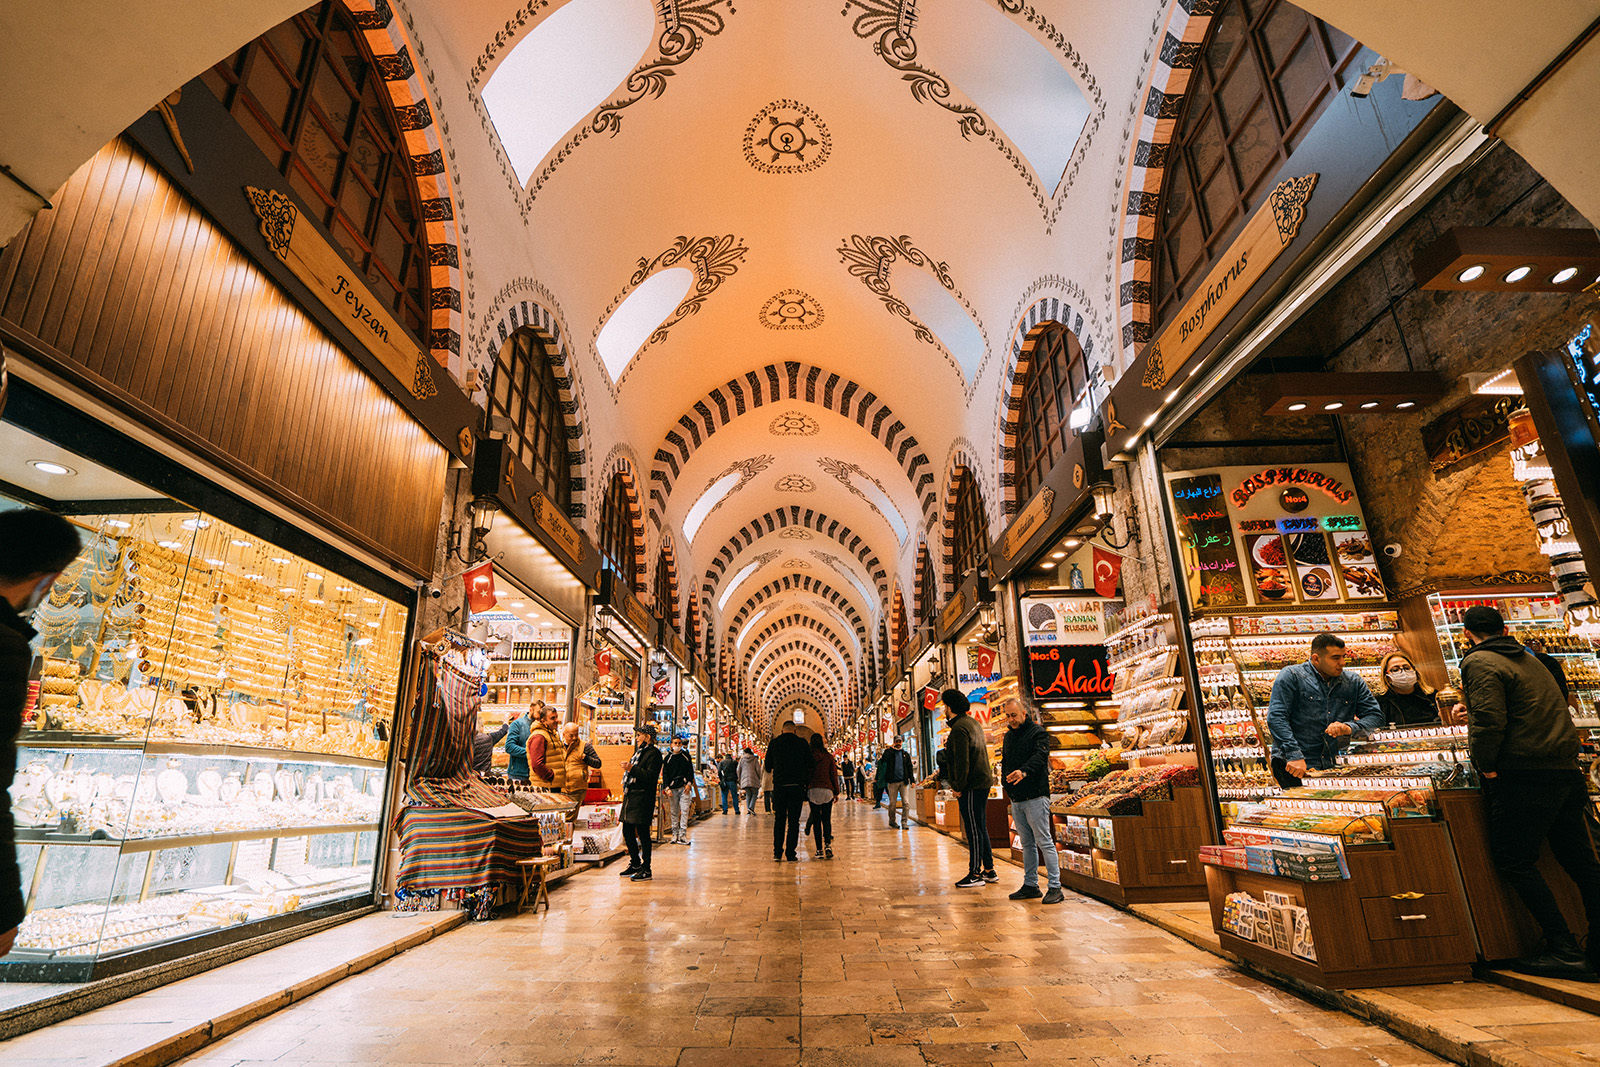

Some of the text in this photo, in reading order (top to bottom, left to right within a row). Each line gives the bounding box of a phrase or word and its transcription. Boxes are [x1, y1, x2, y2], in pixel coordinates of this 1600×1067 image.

[1179, 250, 1249, 344] Bosphorus
[330, 274, 390, 344] Feyzan
[1231, 466, 1355, 509] BOSPHORUS
[1284, 495, 1308, 504] No:4
[1325, 516, 1361, 529] SPICES
[1200, 582, 1234, 596] No:4
[1055, 601, 1101, 613] CAVIAR
[1063, 615, 1097, 623] IRANIAN
[1063, 624, 1099, 633] RUSSIAN
[1030, 648, 1060, 661] No:6
[1035, 658, 1116, 696] Aladd
